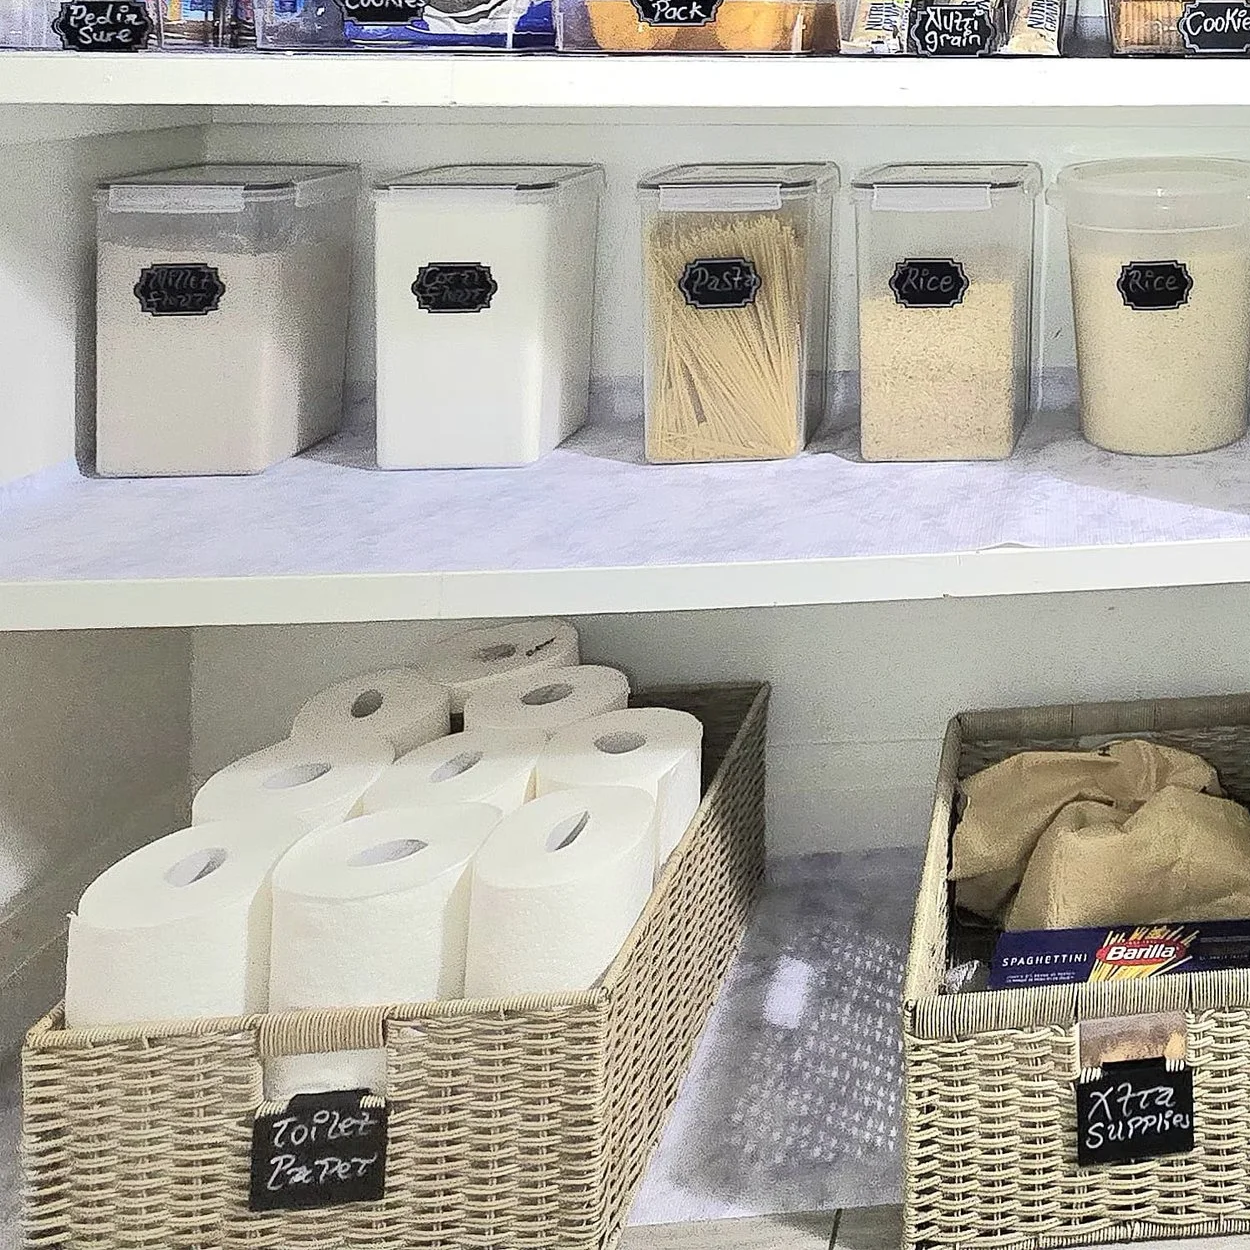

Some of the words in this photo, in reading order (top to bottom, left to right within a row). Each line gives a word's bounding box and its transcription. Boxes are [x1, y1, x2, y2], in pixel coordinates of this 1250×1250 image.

[651, 0, 707, 22] Pack
[864, 1, 884, 32] NUTRI
[78, 26, 133, 45] Sure
[692, 266, 757, 294] Pasta
[899, 267, 954, 293] Rice
[1129, 269, 1180, 292] Rice
[1001, 952, 1088, 968] SPAGHETTINI
[1106, 944, 1179, 962] Barilla
[267, 1152, 378, 1191] Paper
